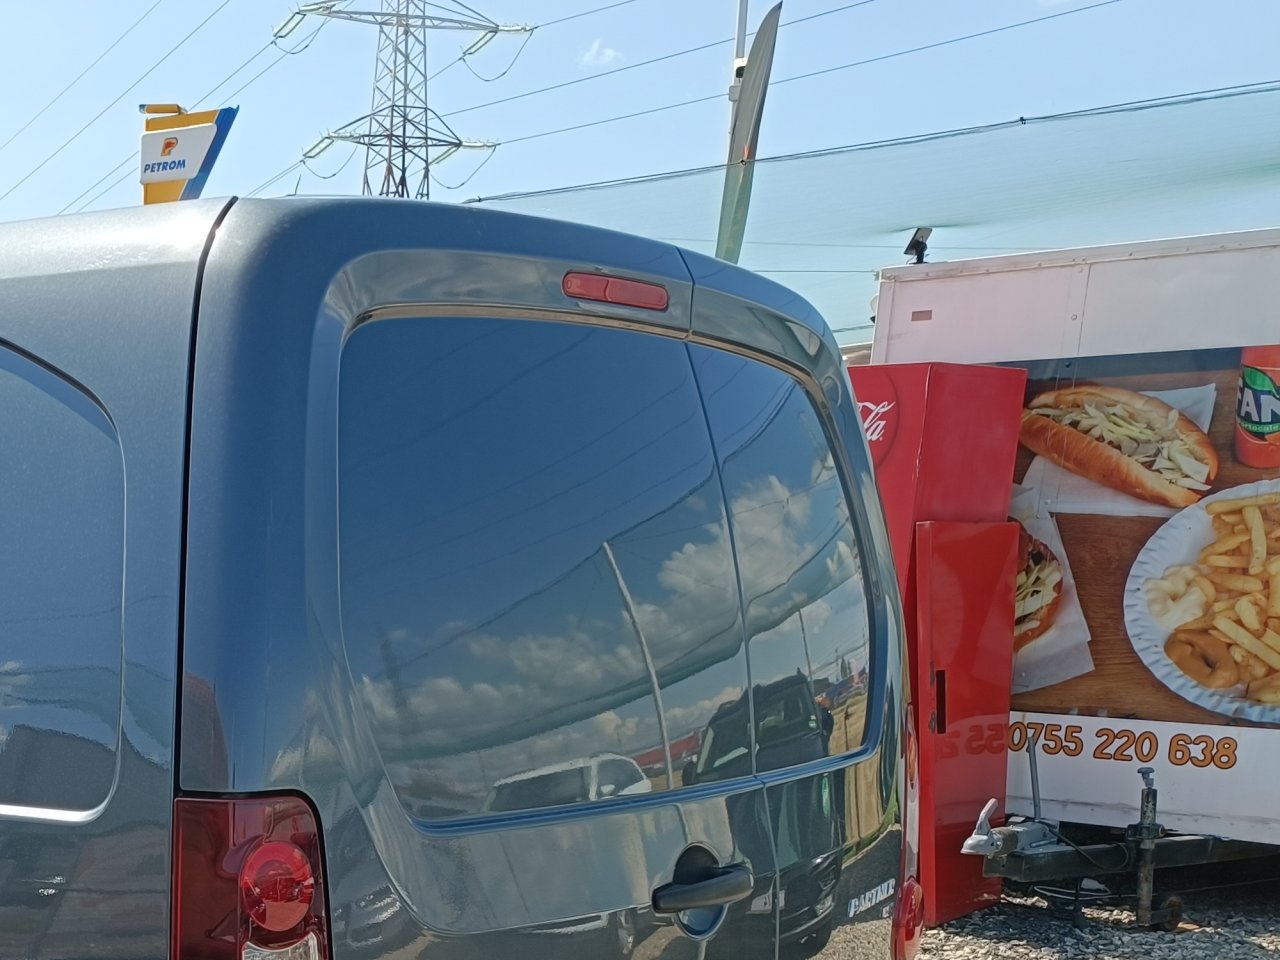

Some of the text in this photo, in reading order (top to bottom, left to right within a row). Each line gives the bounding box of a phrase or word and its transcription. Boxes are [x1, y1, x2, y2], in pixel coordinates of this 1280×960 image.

[143, 159, 186, 174] PETROM
[1007, 721, 1238, 769] 0755 220 638
